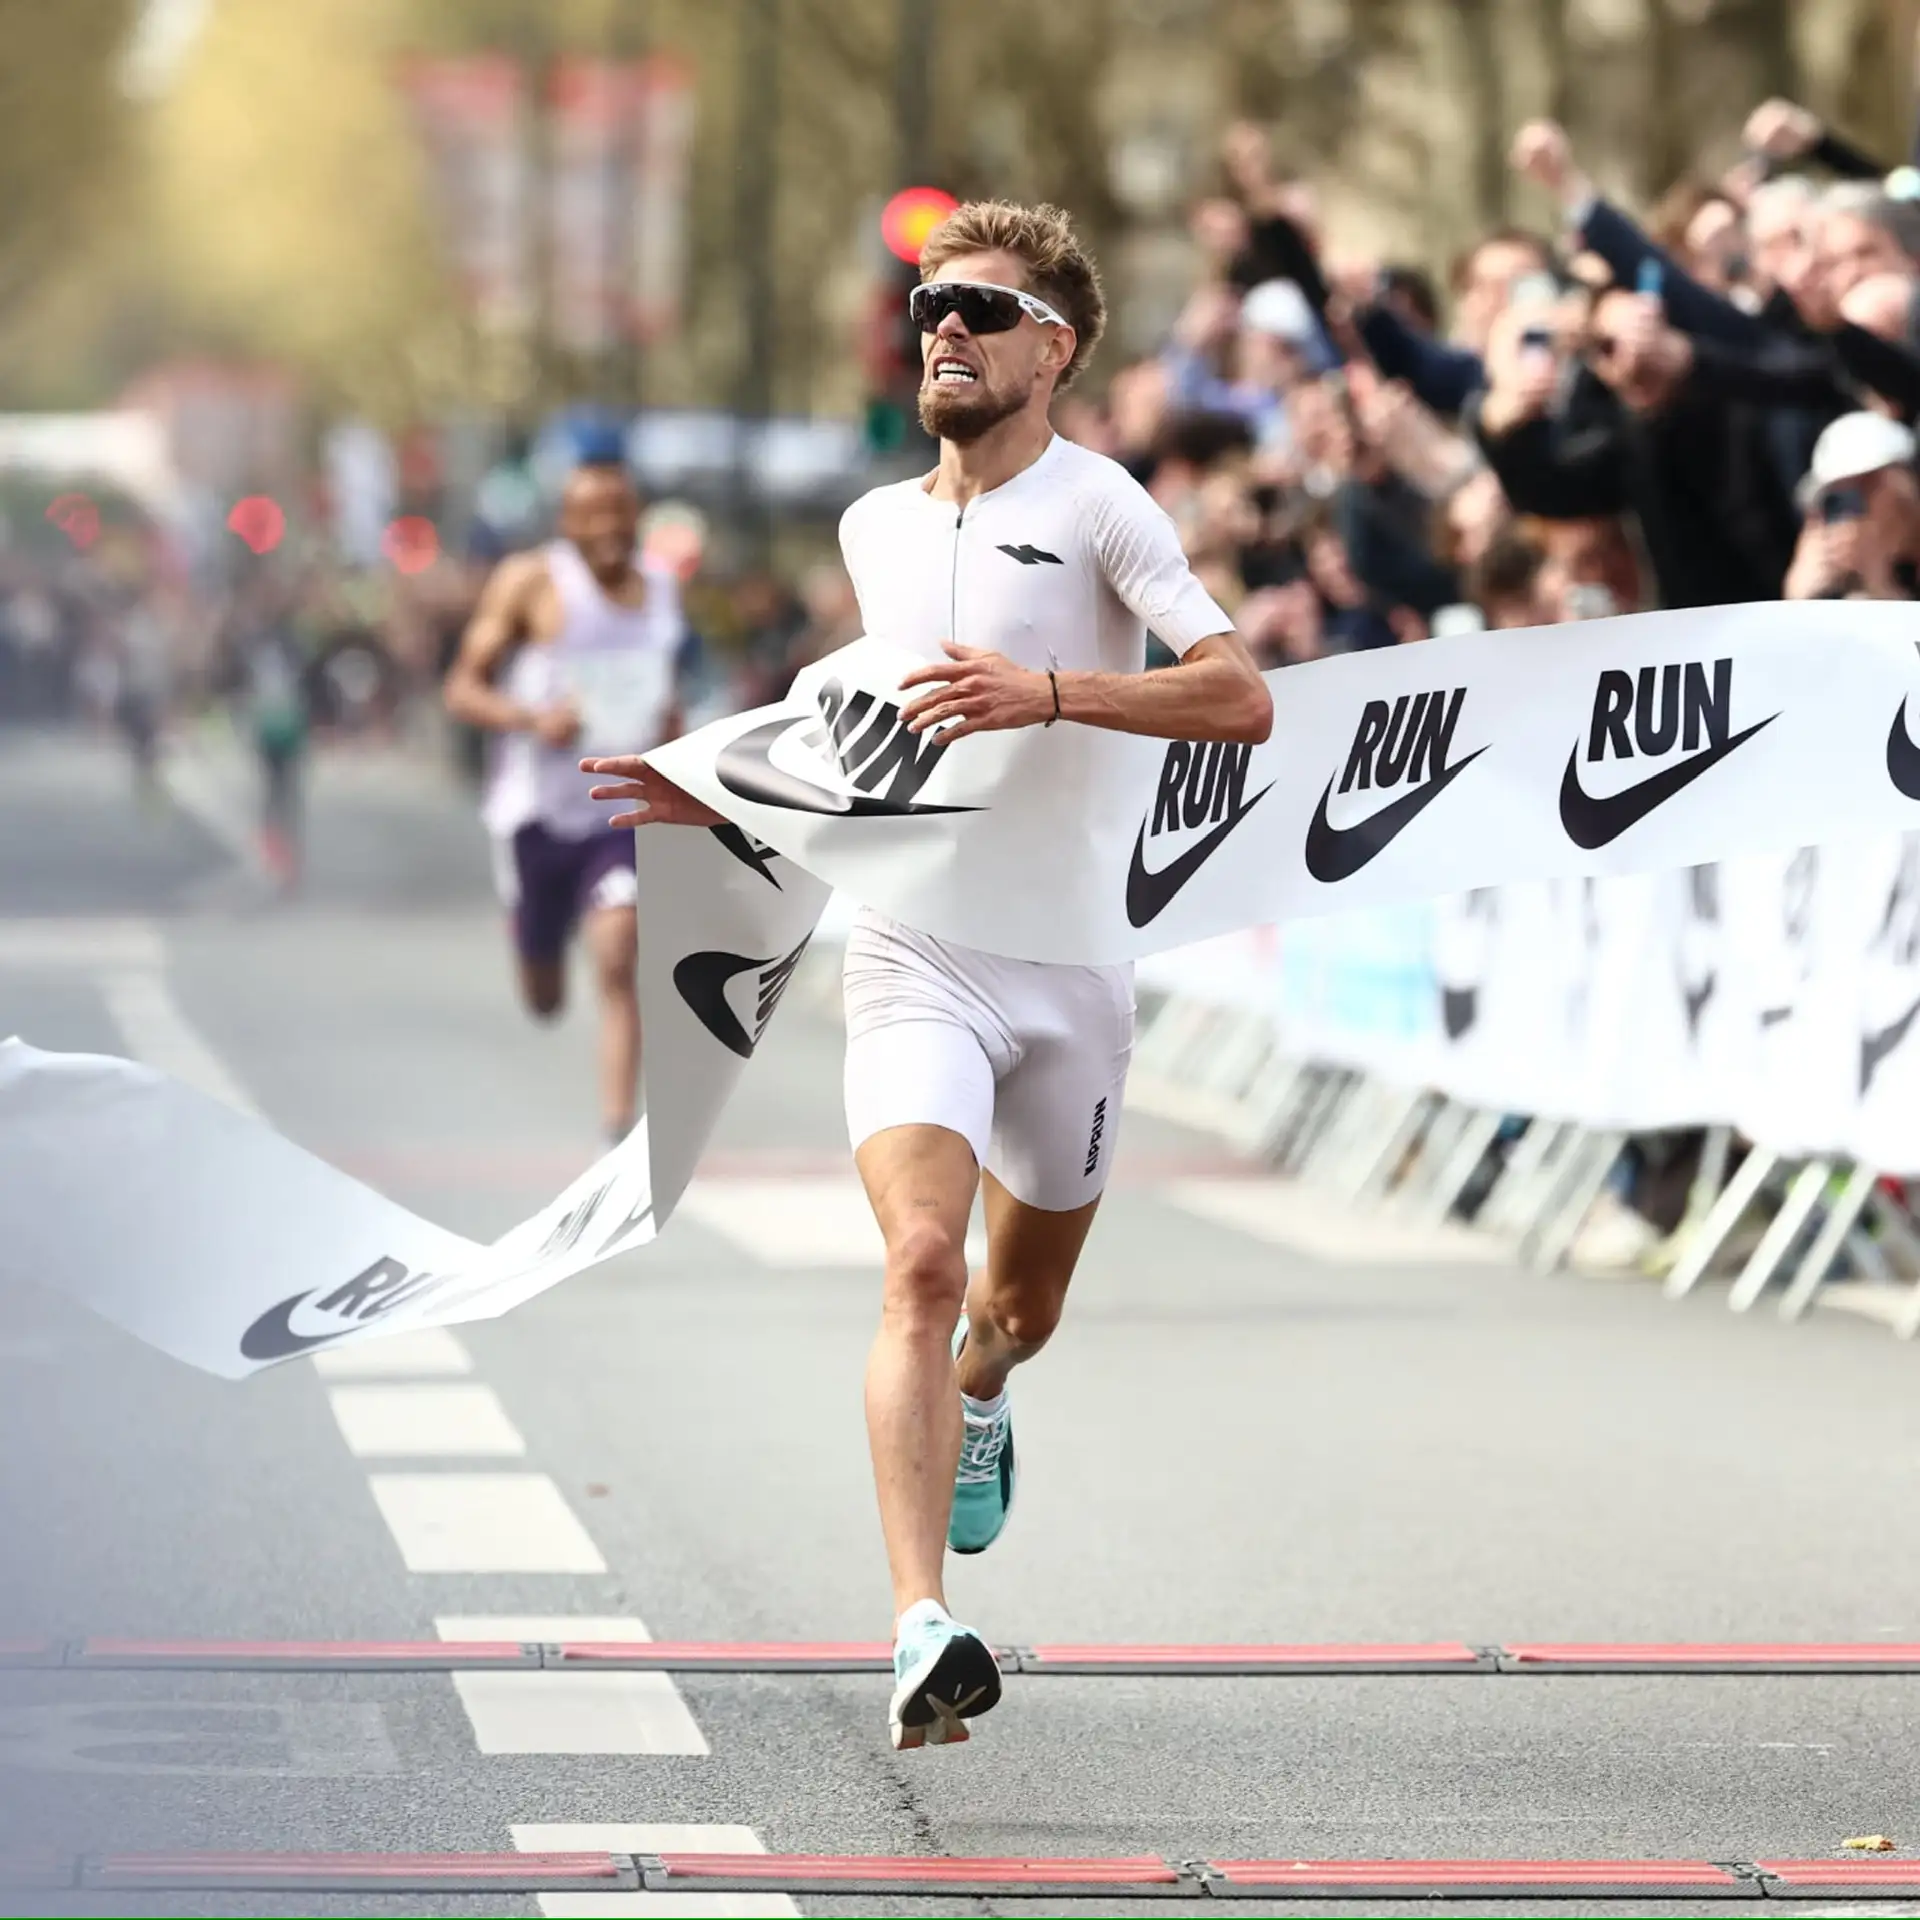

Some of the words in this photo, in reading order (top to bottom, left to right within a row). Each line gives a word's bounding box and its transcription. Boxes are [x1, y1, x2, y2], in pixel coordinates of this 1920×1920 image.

[1337, 687, 1467, 794] RUN
[1587, 658, 1733, 762] RUN
[1151, 741, 1253, 837] RUN
[1083, 1096, 1108, 1178] KIPRUN
